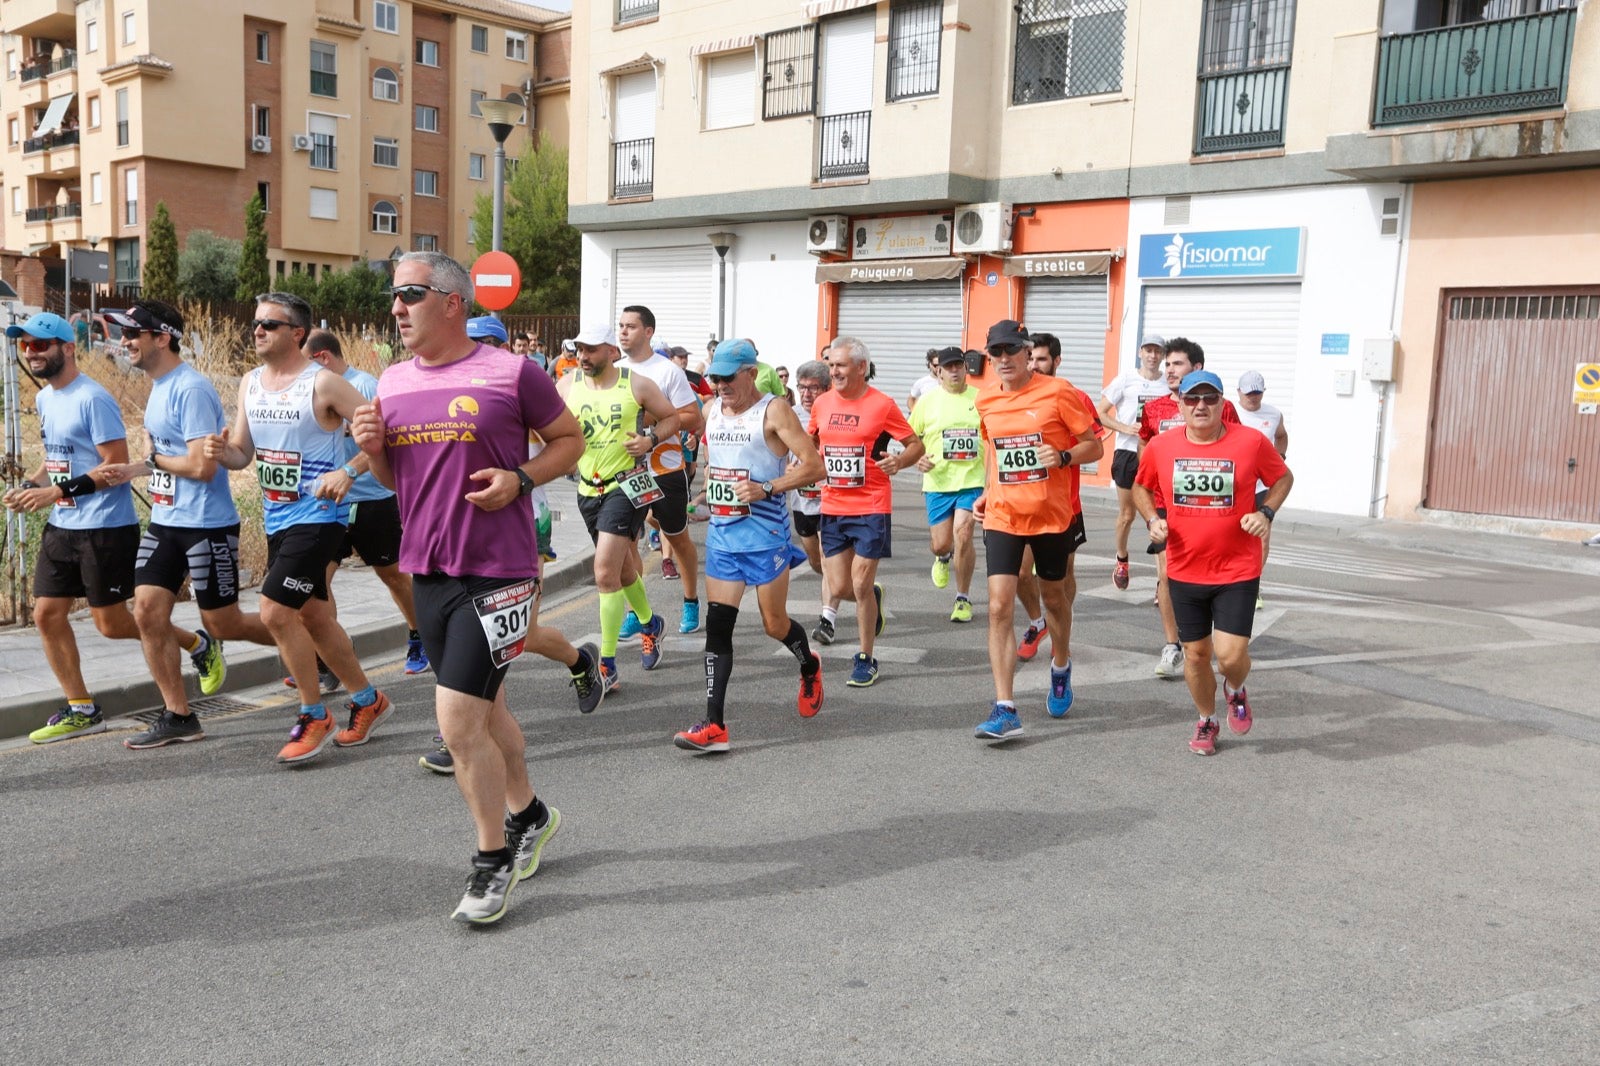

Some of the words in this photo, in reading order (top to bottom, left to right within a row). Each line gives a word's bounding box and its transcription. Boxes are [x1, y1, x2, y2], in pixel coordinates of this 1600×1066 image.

[1182, 242, 1272, 269] fisiomar
[1024, 258, 1085, 273] Estetica
[425, 421, 477, 431] MONTAÑA
[830, 415, 858, 426] FILA
[709, 432, 751, 442] MARACENA
[949, 438, 974, 450] 790
[828, 458, 860, 472] 3031
[1003, 449, 1037, 468] 468
[258, 464, 298, 487] 1065
[628, 473, 653, 493] 858
[1183, 474, 1225, 493] 330
[709, 482, 742, 502] 105
[211, 541, 236, 598] SPORTLAST
[493, 601, 533, 639] 301
